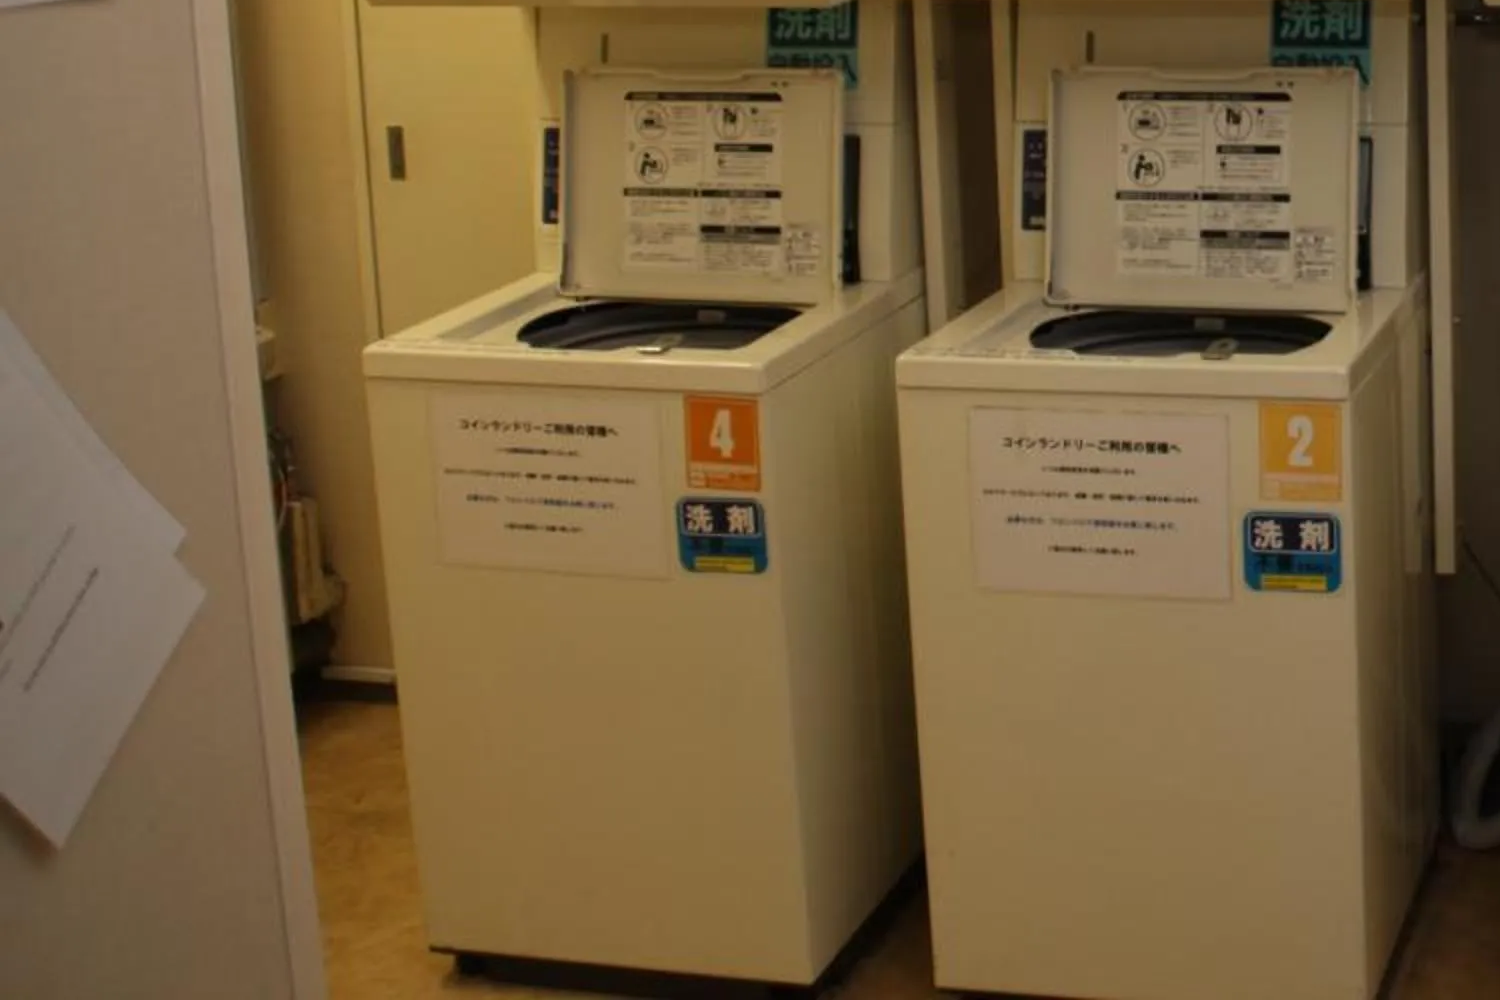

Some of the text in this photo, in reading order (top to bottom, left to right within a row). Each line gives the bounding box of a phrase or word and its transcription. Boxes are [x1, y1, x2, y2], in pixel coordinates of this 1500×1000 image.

[775, 4, 851, 41] 洗剤
[1280, 0, 1363, 41] 洗剤
[709, 408, 735, 458] 4
[1286, 414, 1314, 468] 2
[685, 503, 755, 536] 洗剤
[1253, 519, 1331, 551] 洗剤
